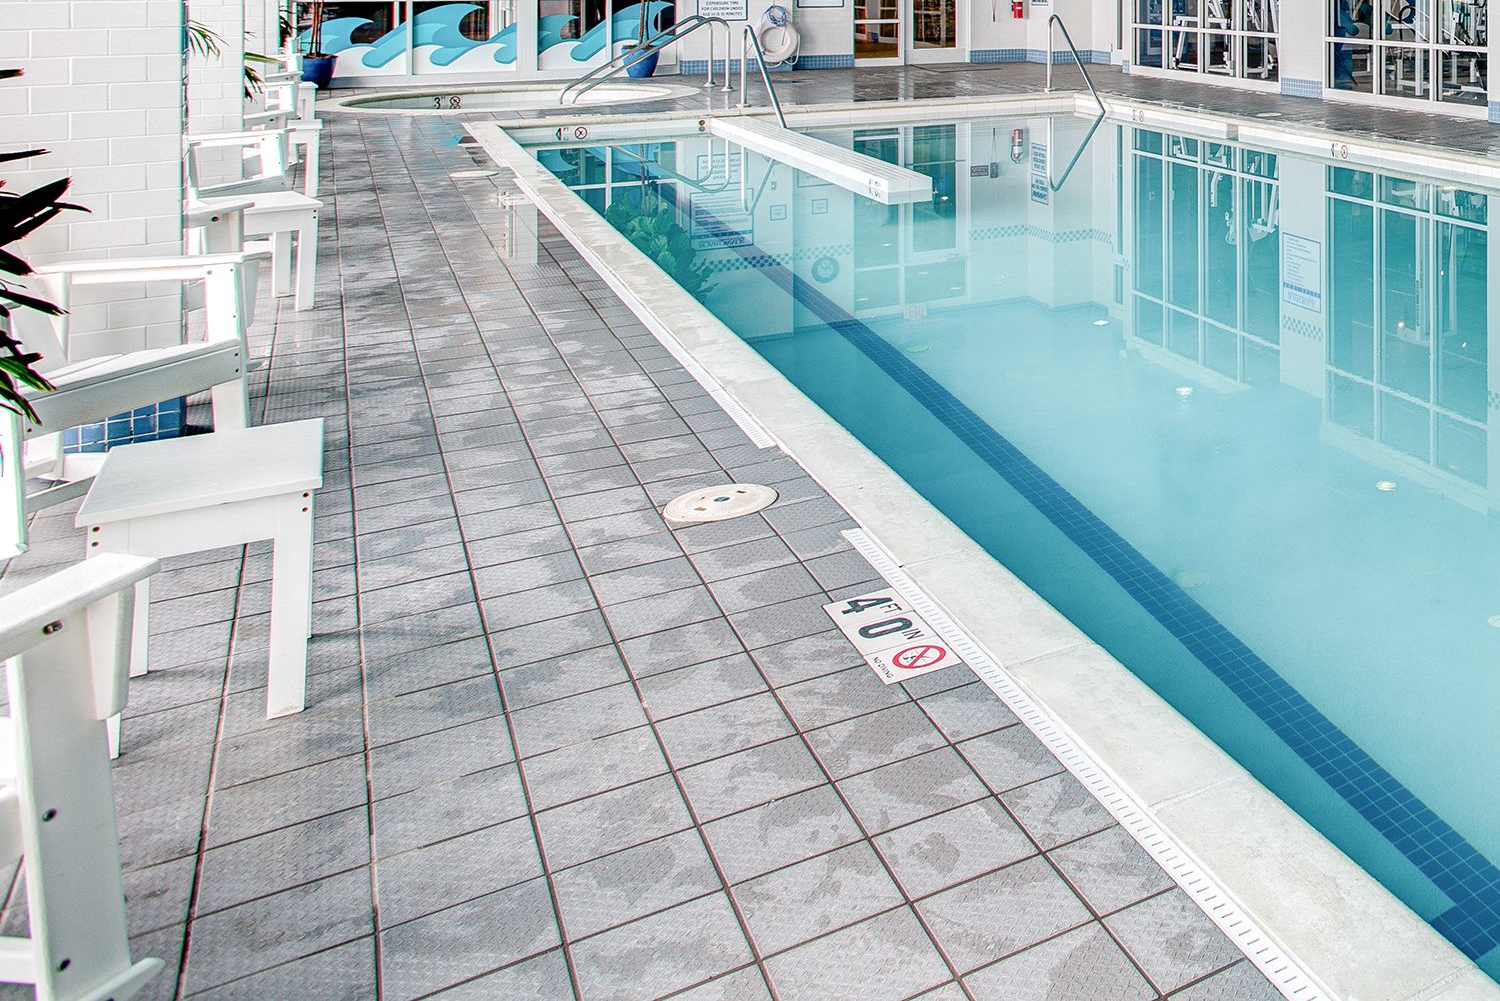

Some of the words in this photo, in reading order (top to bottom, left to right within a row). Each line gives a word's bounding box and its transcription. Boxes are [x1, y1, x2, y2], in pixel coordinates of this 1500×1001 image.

[841, 597, 893, 615] 4
[880, 603, 903, 614] FT
[858, 617, 913, 639] 0
[902, 628, 925, 640] IN
